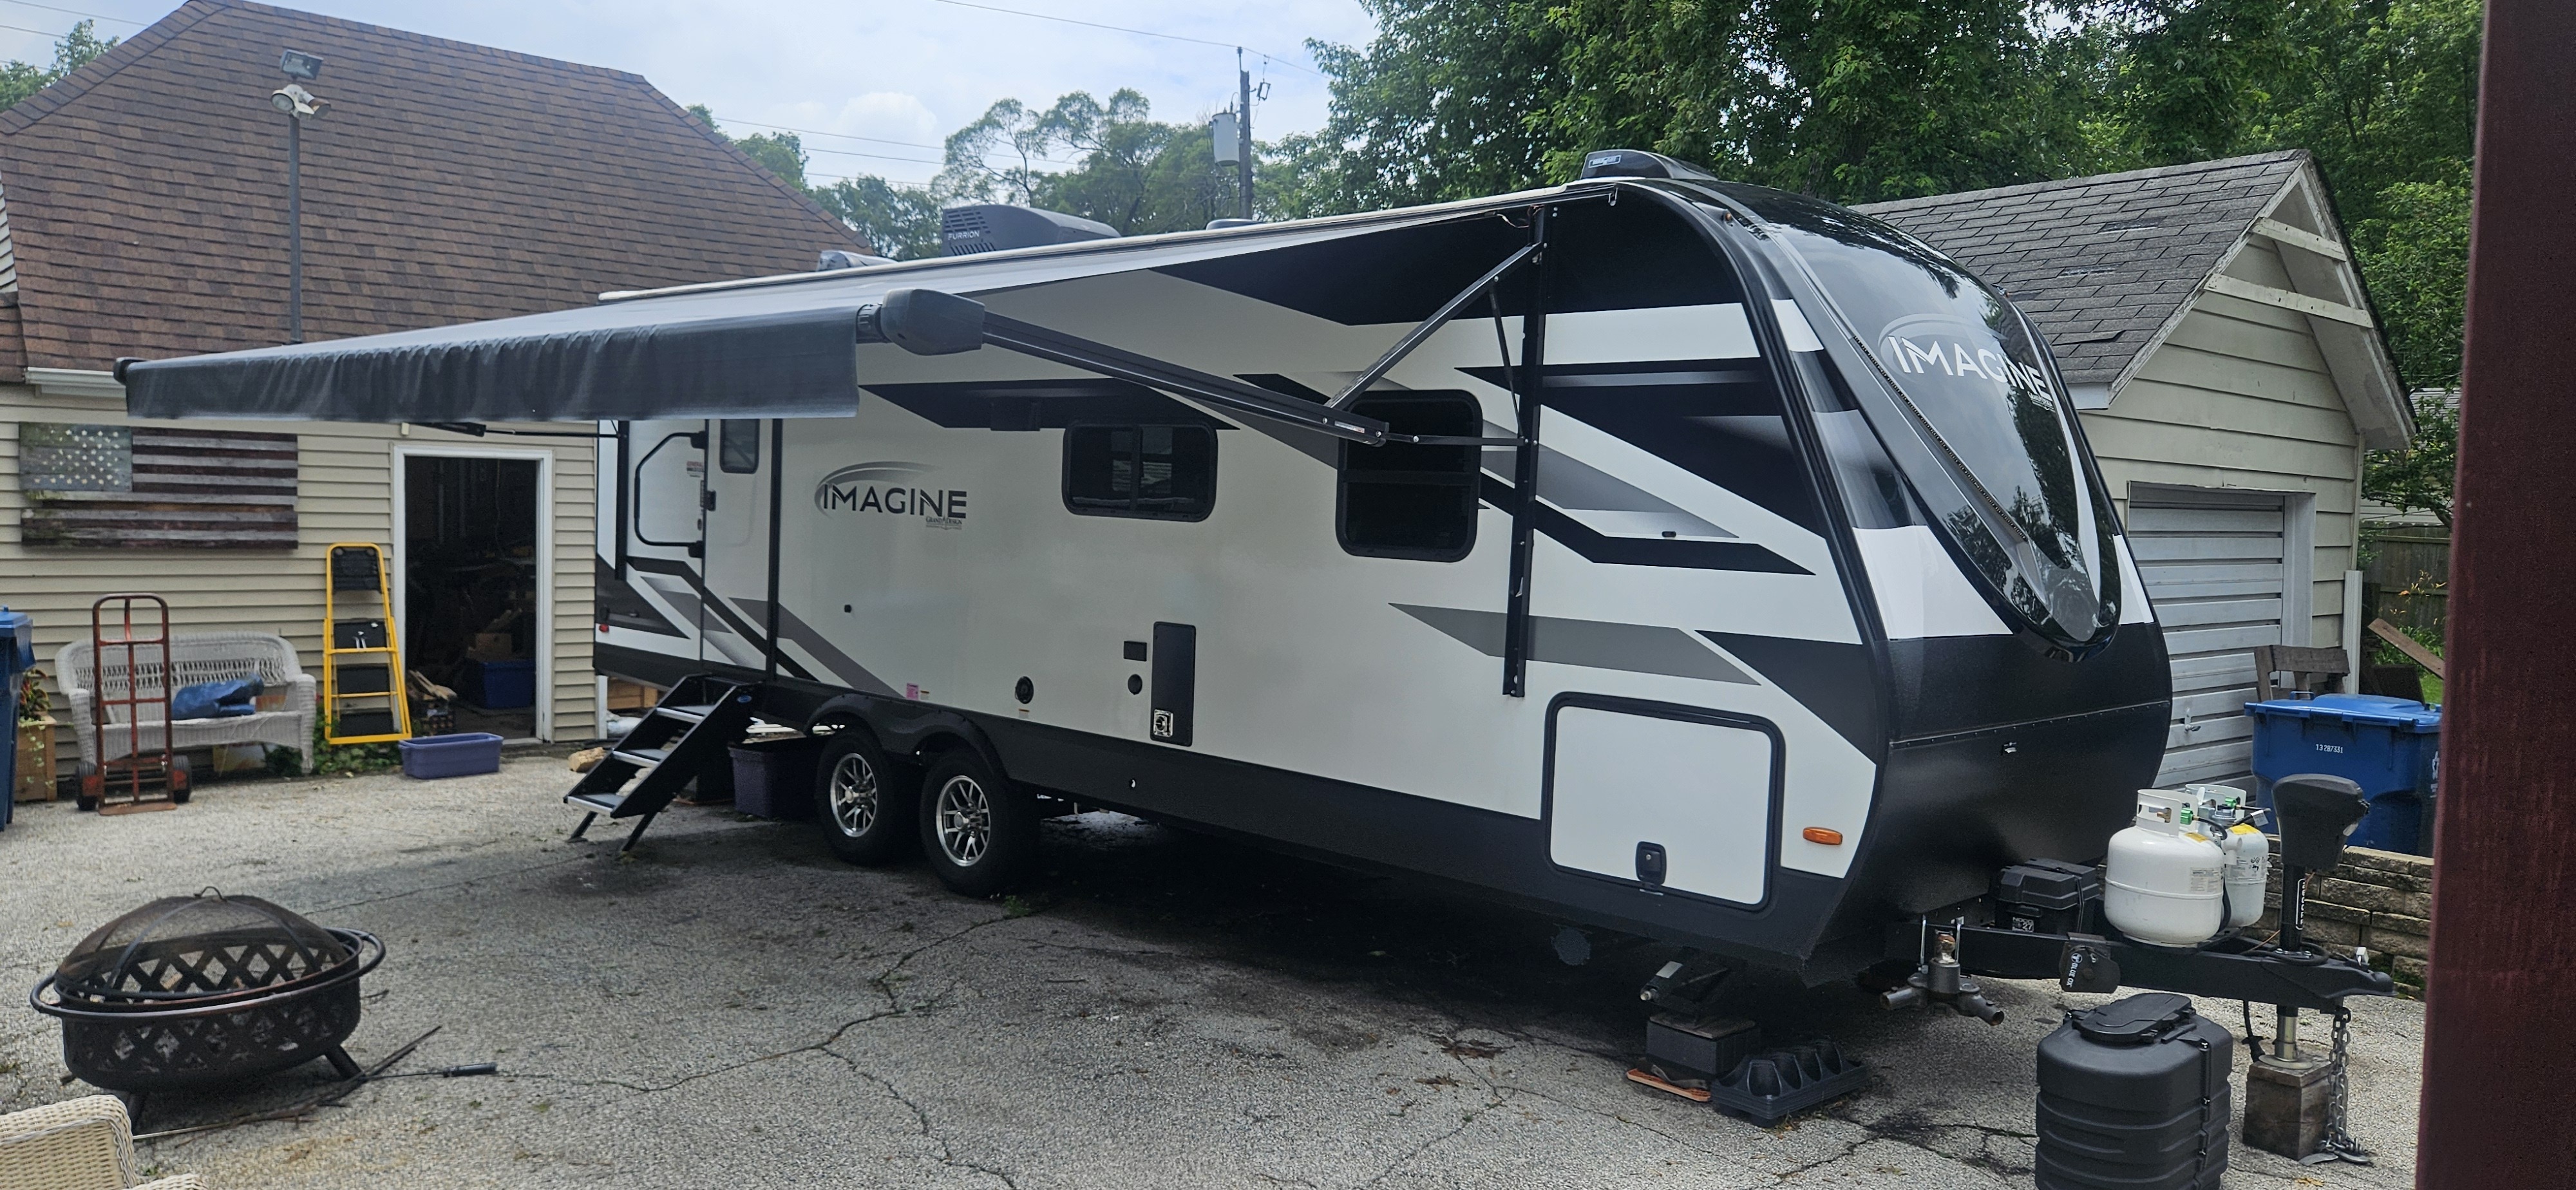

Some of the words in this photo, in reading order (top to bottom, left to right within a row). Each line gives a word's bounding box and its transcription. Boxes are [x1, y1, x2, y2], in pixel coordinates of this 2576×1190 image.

[948, 230, 980, 240] FURRION
[1888, 335, 2053, 402] IMAGINE
[824, 484, 967, 519] IMAGINE
[2069, 963, 2078, 978] BLUE
[2066, 978, 2074, 988] OX
